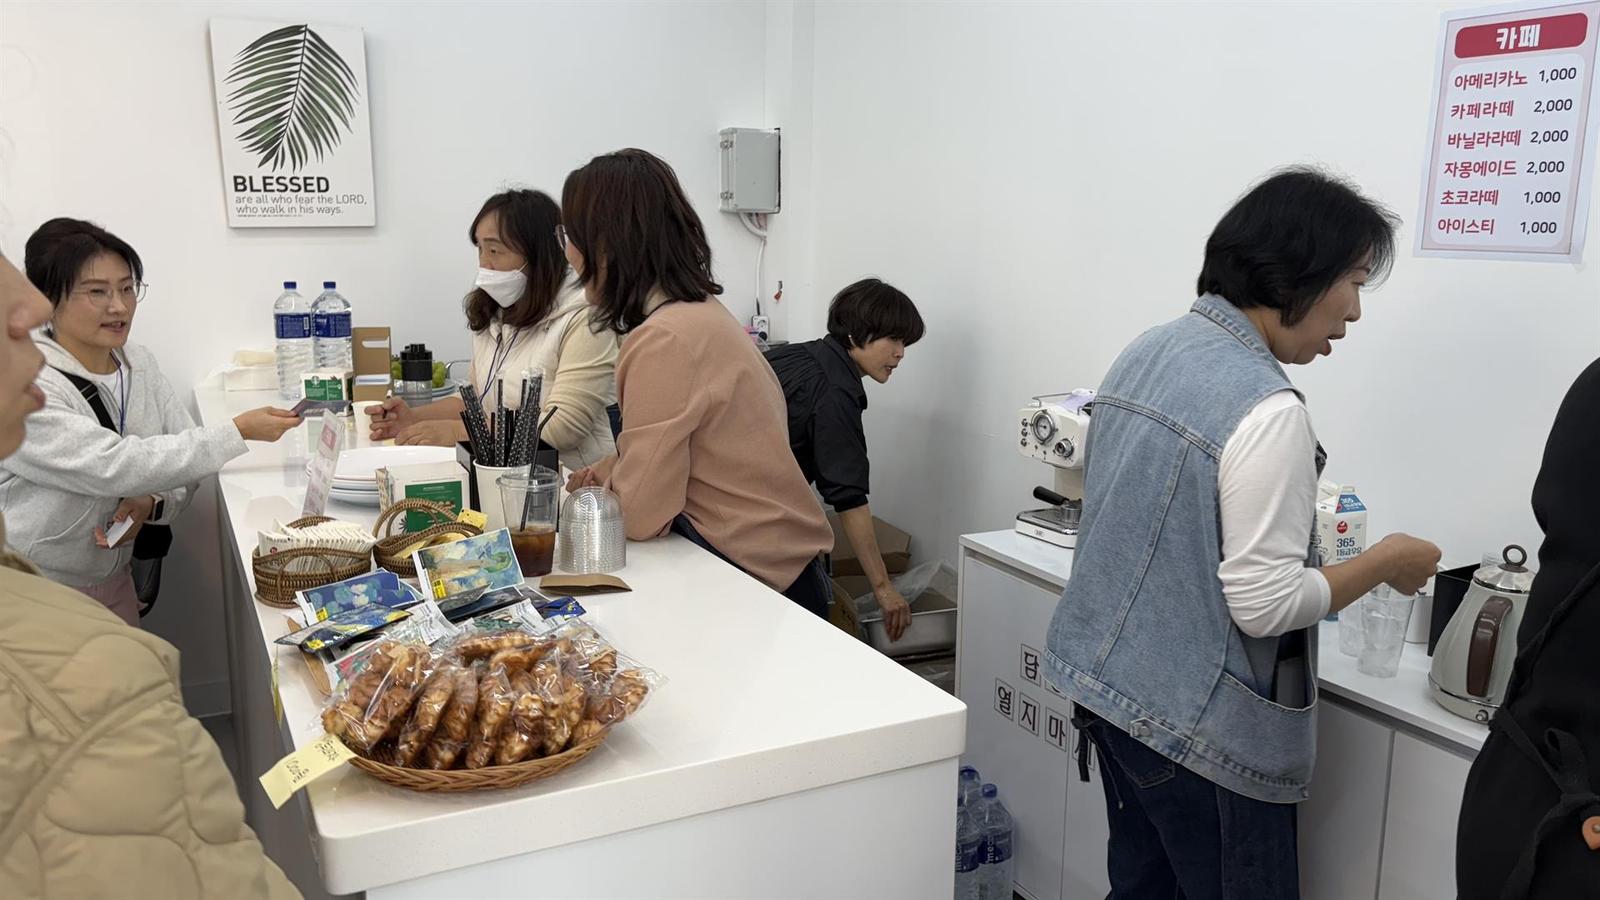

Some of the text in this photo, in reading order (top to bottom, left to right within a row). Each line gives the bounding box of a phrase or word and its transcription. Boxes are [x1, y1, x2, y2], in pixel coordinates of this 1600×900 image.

[1495, 24, 1541, 50] 카페
[1454, 67, 1577, 90] 아메리카노 1,000
[1450, 98, 1573, 119] 카페라떼 2,000
[1447, 129, 1569, 150] 바닐라라떼 2,000
[1444, 160, 1565, 179] 자몽에이드 2,000
[233, 175, 330, 193] BLESSED
[235, 194, 368, 205] are all who fear the LORD,
[1440, 189, 1561, 206] 초코라떼 1,000
[235, 204, 344, 216] who walk in his ways.
[1437, 218, 1557, 235] 아이스티 1,000
[1336, 537, 1355, 549] 365
[998, 686, 1037, 731] 열지
